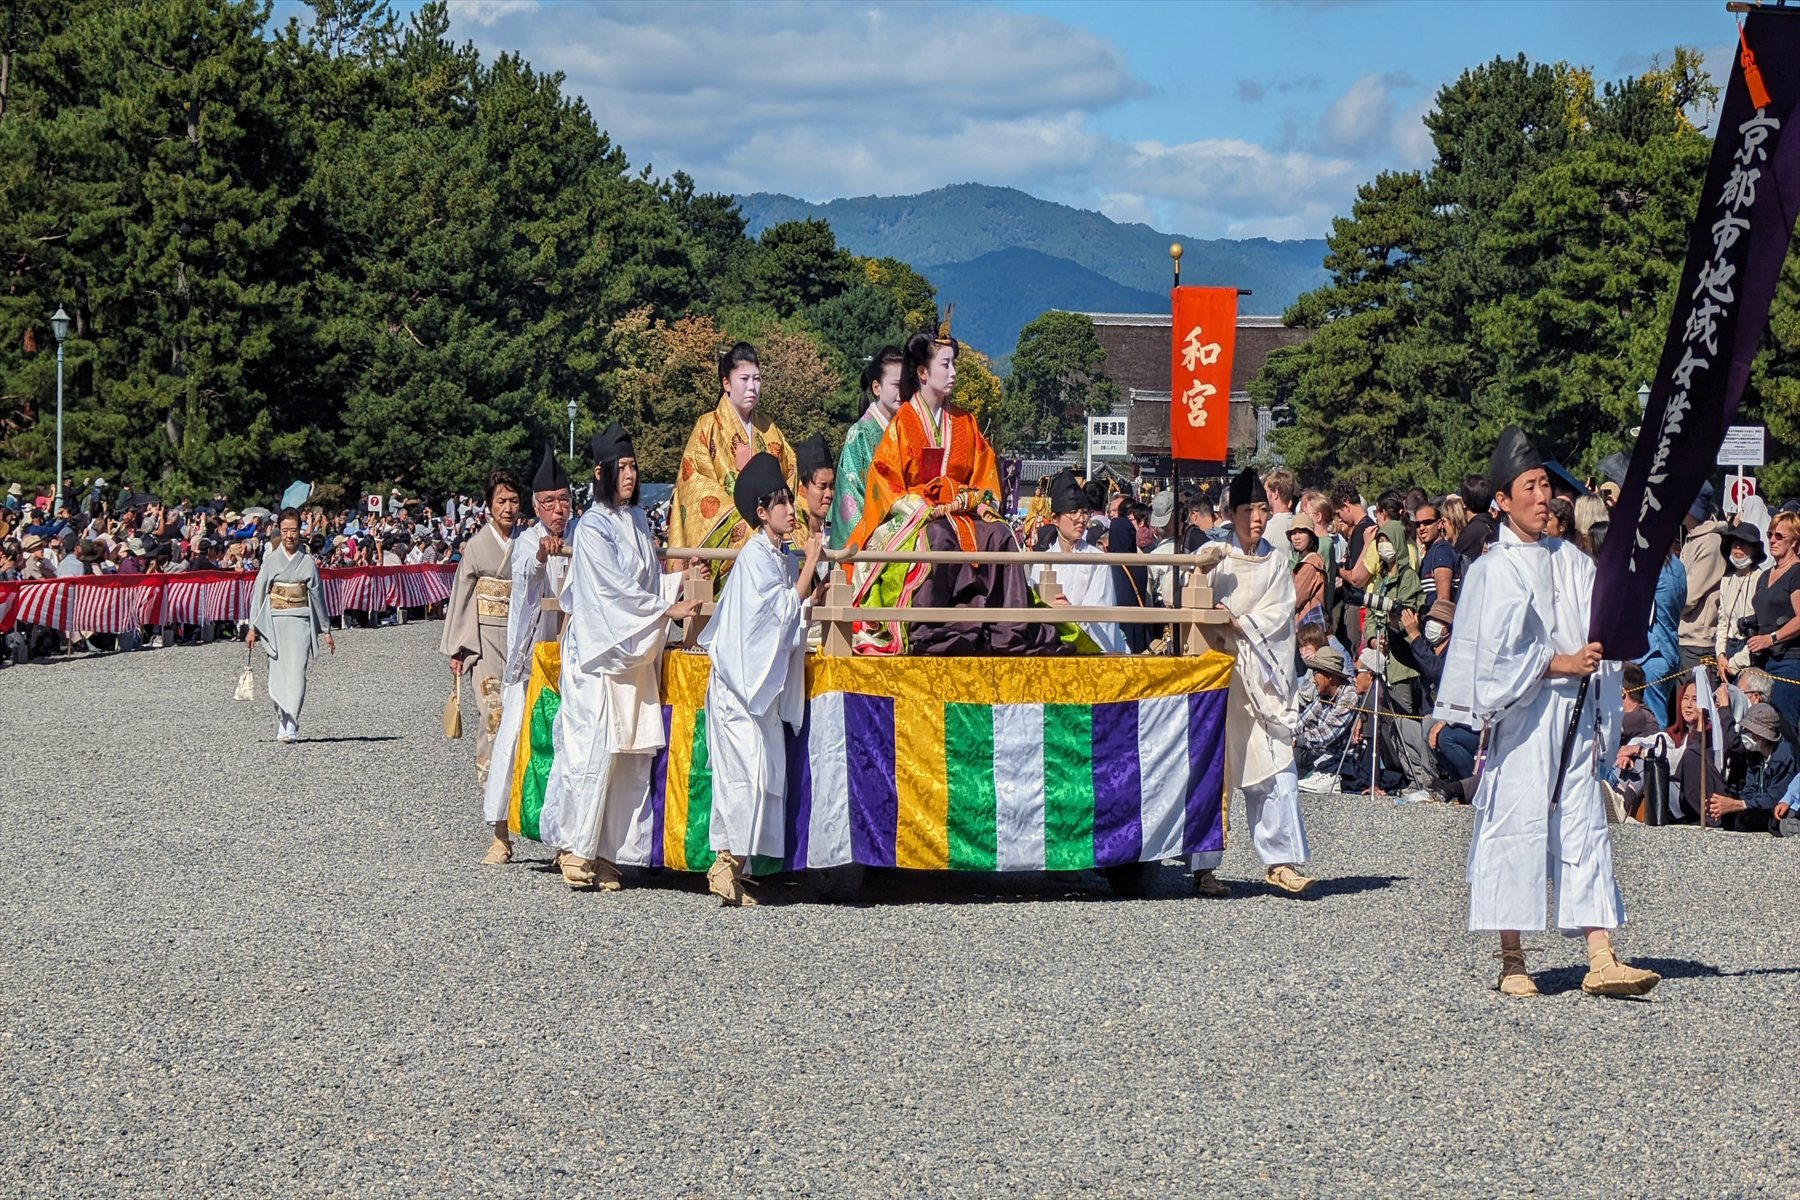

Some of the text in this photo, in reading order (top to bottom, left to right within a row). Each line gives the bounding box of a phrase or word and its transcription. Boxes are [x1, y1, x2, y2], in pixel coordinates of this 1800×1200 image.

[1181, 326, 1222, 428] 和宮
[1093, 422, 1125, 435] 横断通路
